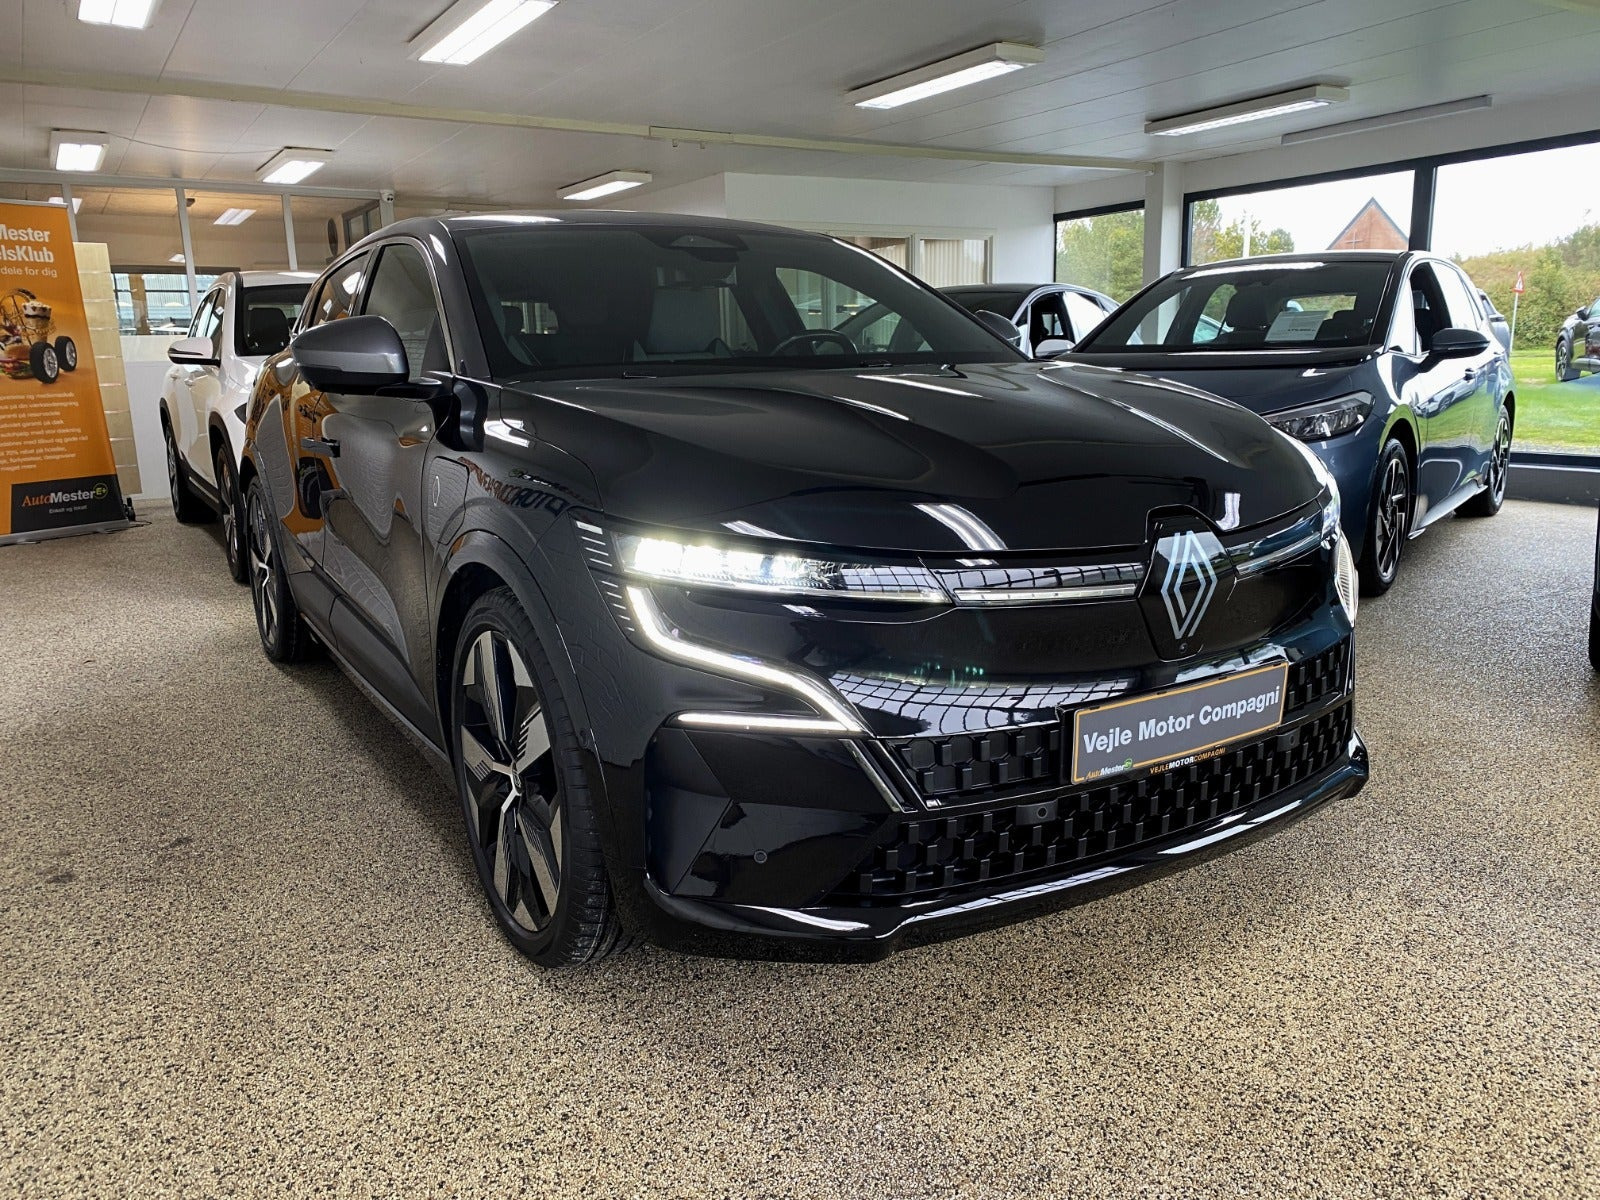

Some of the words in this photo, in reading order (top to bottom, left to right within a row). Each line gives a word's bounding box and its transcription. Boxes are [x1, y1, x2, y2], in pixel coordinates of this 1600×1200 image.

[0, 245, 54, 262] lsKlub
[25, 266, 39, 275] for
[41, 267, 58, 278] dig
[22, 490, 95, 507] AutoMester
[1083, 727, 1132, 753] Vejle
[1138, 713, 1195, 742] Motor
[1199, 686, 1281, 726] Compagni
